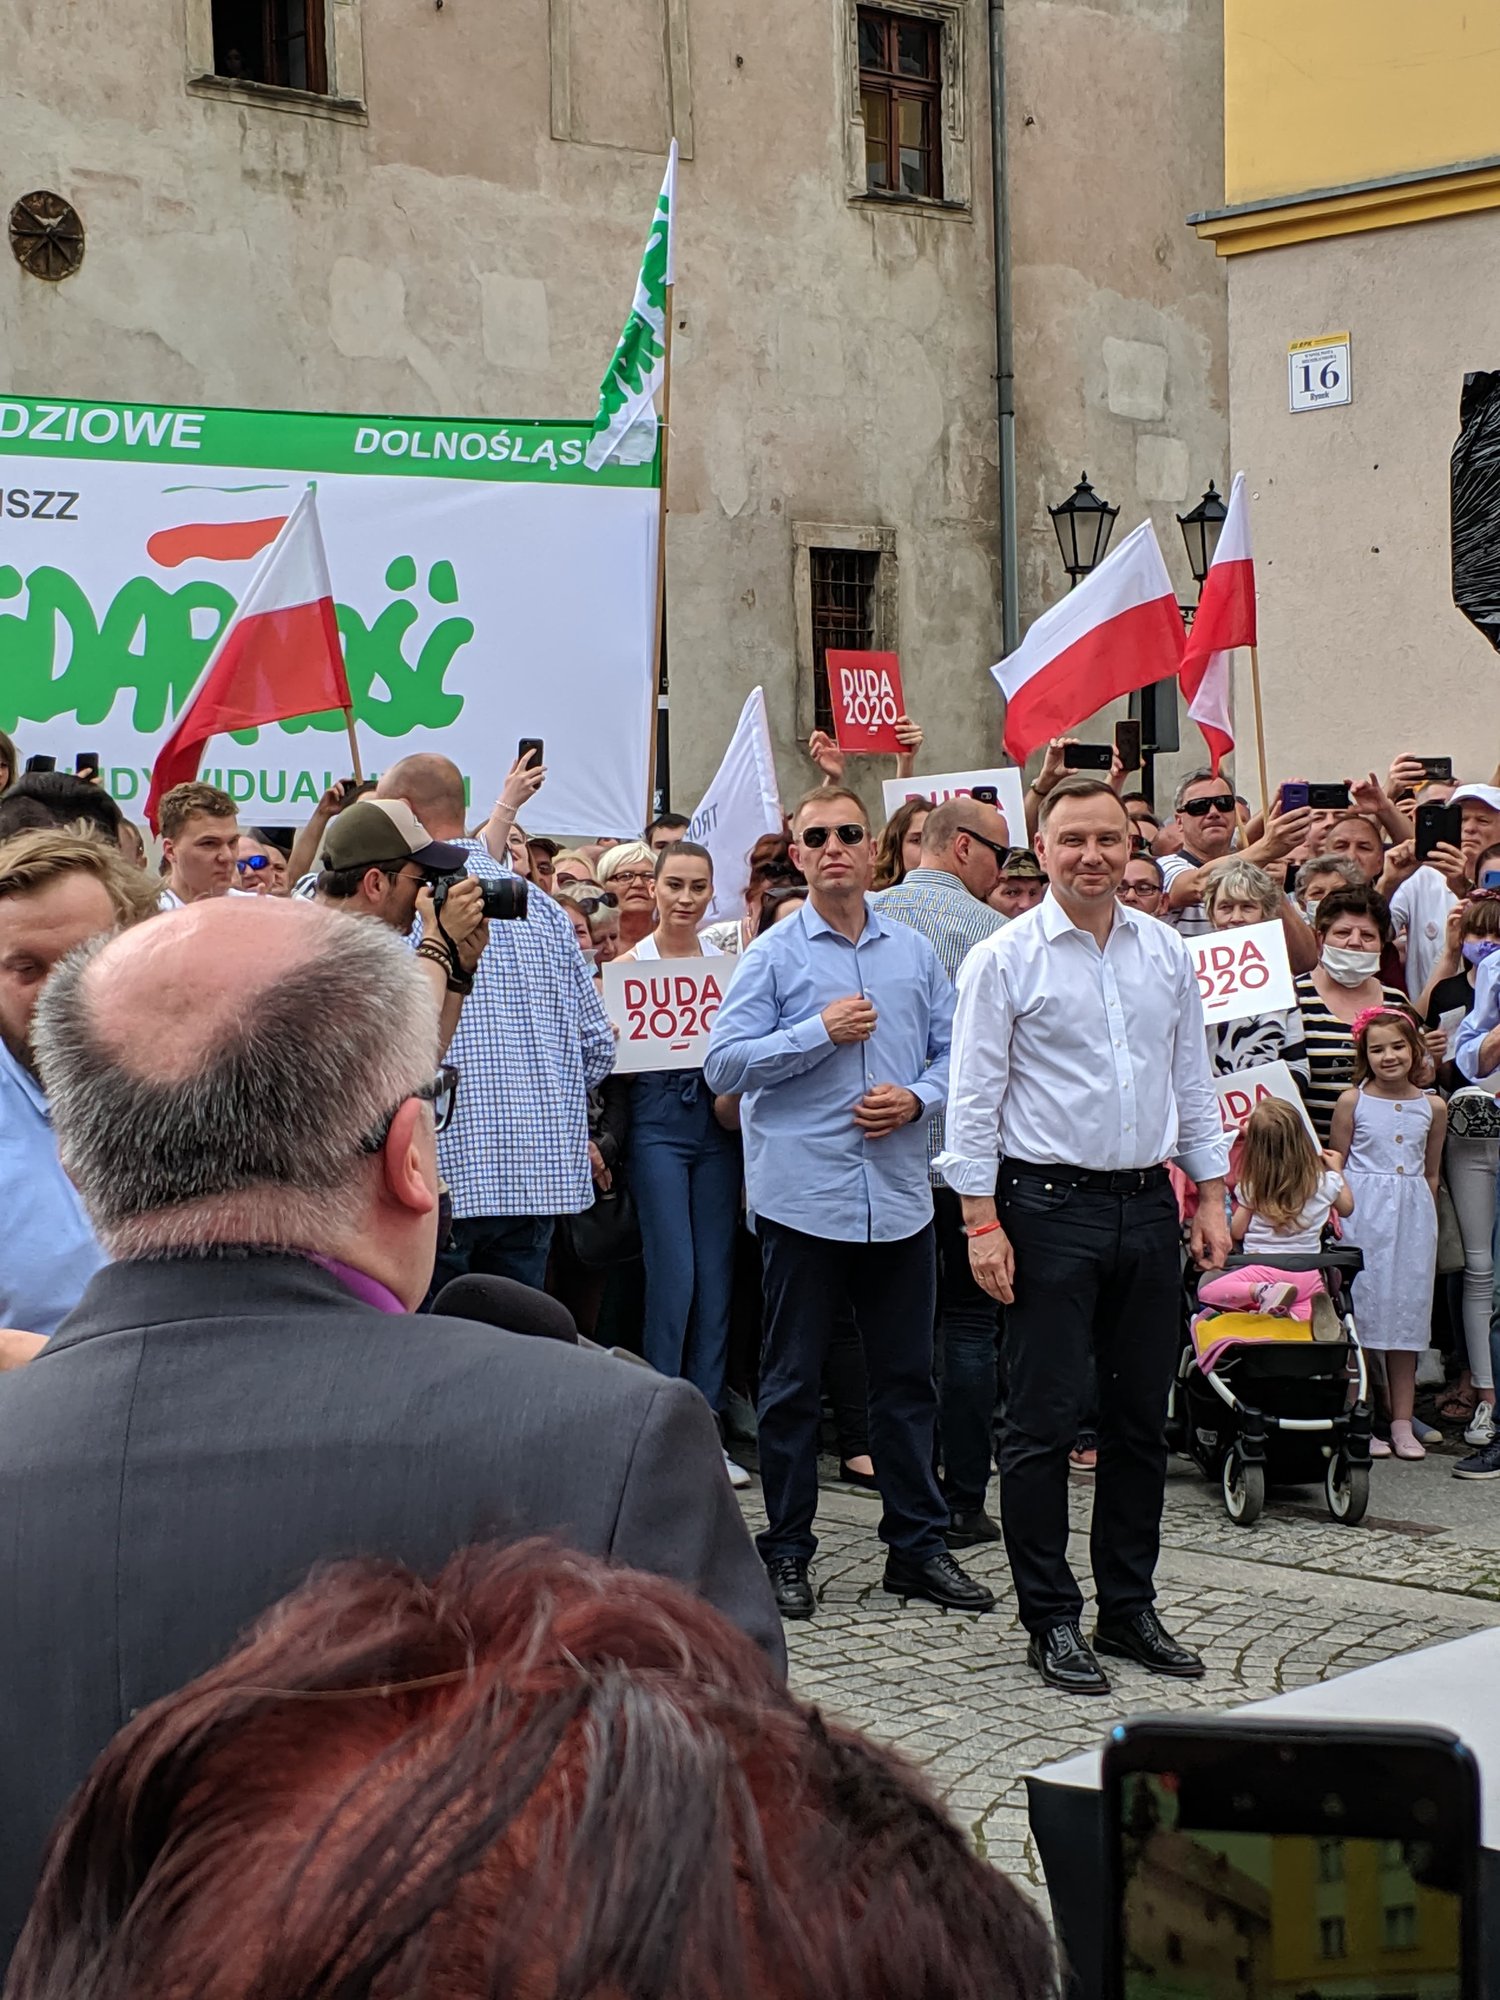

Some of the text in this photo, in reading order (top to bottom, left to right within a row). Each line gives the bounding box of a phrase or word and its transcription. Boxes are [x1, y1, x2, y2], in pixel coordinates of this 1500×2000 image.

[1299, 359, 1340, 393] 16
[0, 403, 590, 471] DZIOWE DOLNOŚLĄS
[0, 488, 80, 521] SZZ
[840, 667, 895, 698] DUDA
[843, 696, 897, 725] 2020
[624, 974, 723, 1010] DUDA
[1197, 963, 1270, 999] 020
